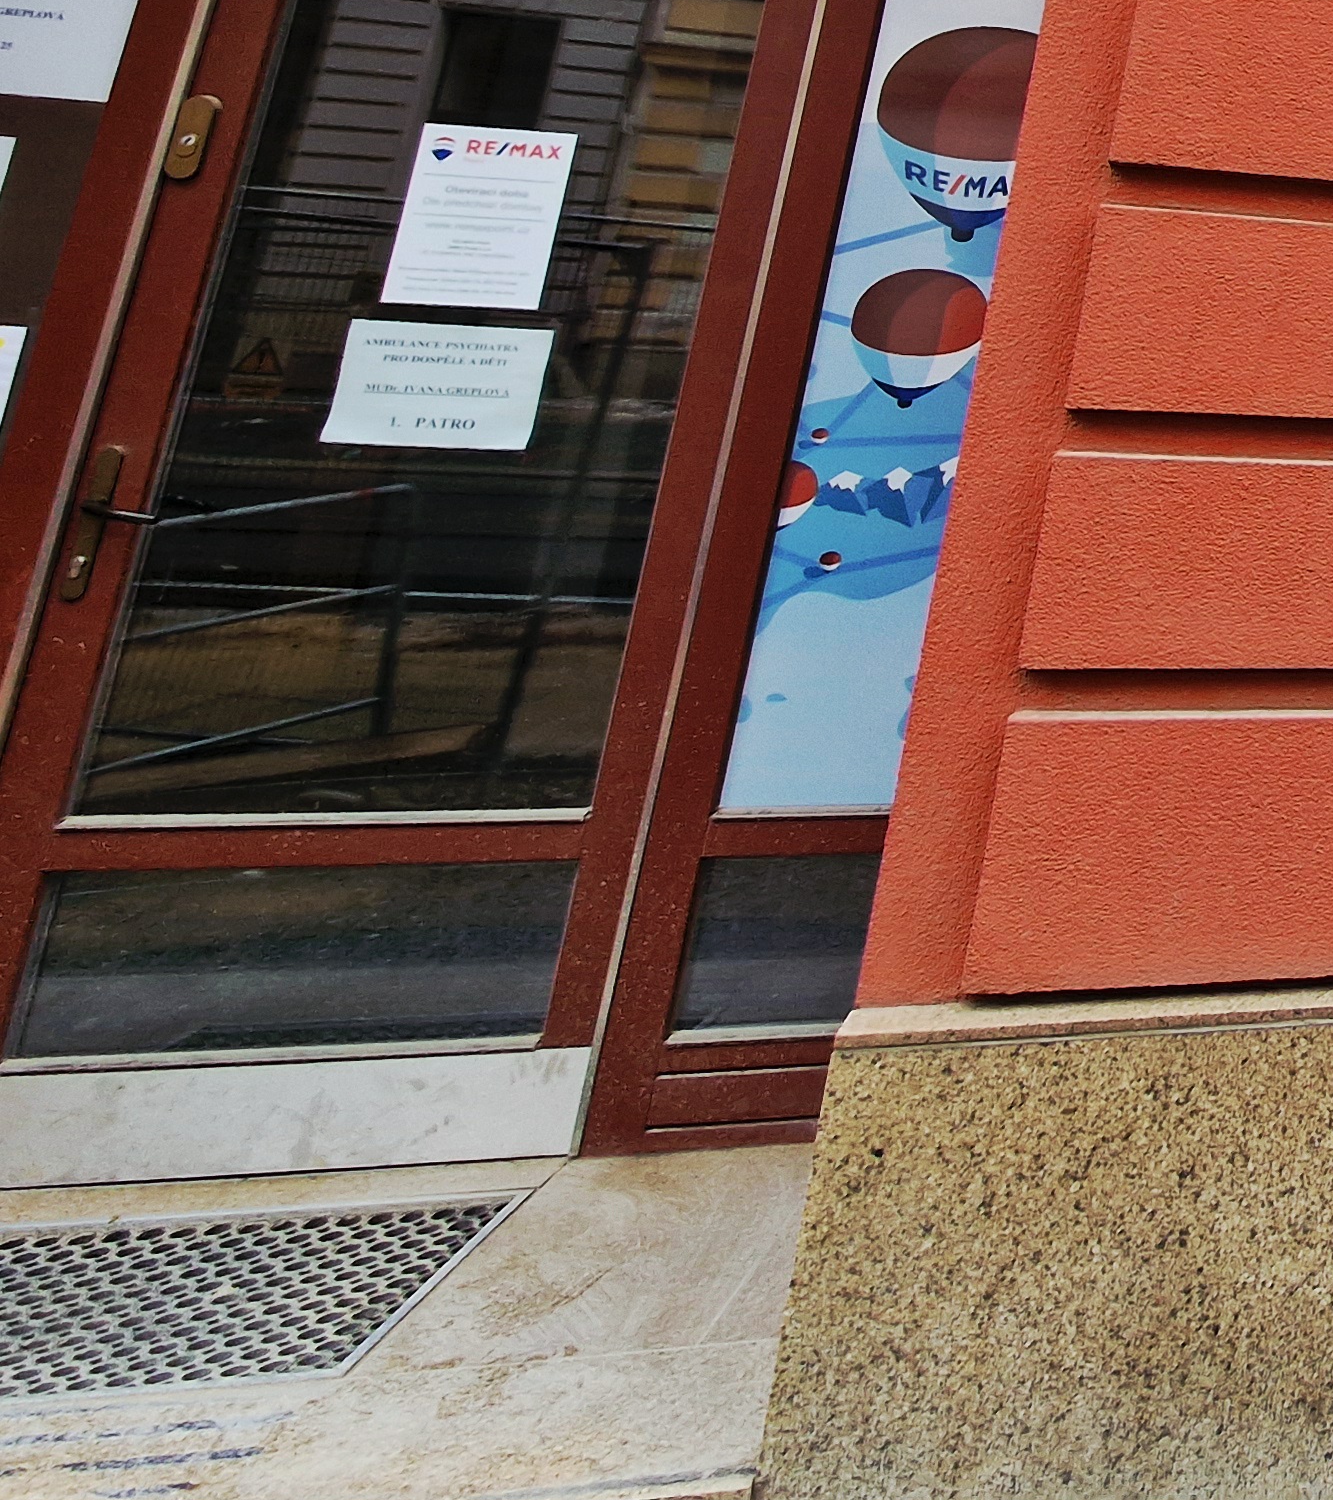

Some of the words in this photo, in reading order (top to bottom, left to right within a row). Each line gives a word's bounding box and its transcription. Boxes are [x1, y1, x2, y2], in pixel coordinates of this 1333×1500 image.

[466, 138, 563, 160] RE/MAX
[904, 160, 1009, 198] RE/MA
[364, 337, 440, 349] AMBULANCE
[444, 341, 519, 353] PSYCHIATRA
[383, 353, 409, 363] PRO
[467, 357, 476, 366] A
[403, 384, 443, 396] IVANA
[415, 417, 475, 431] PATRO
